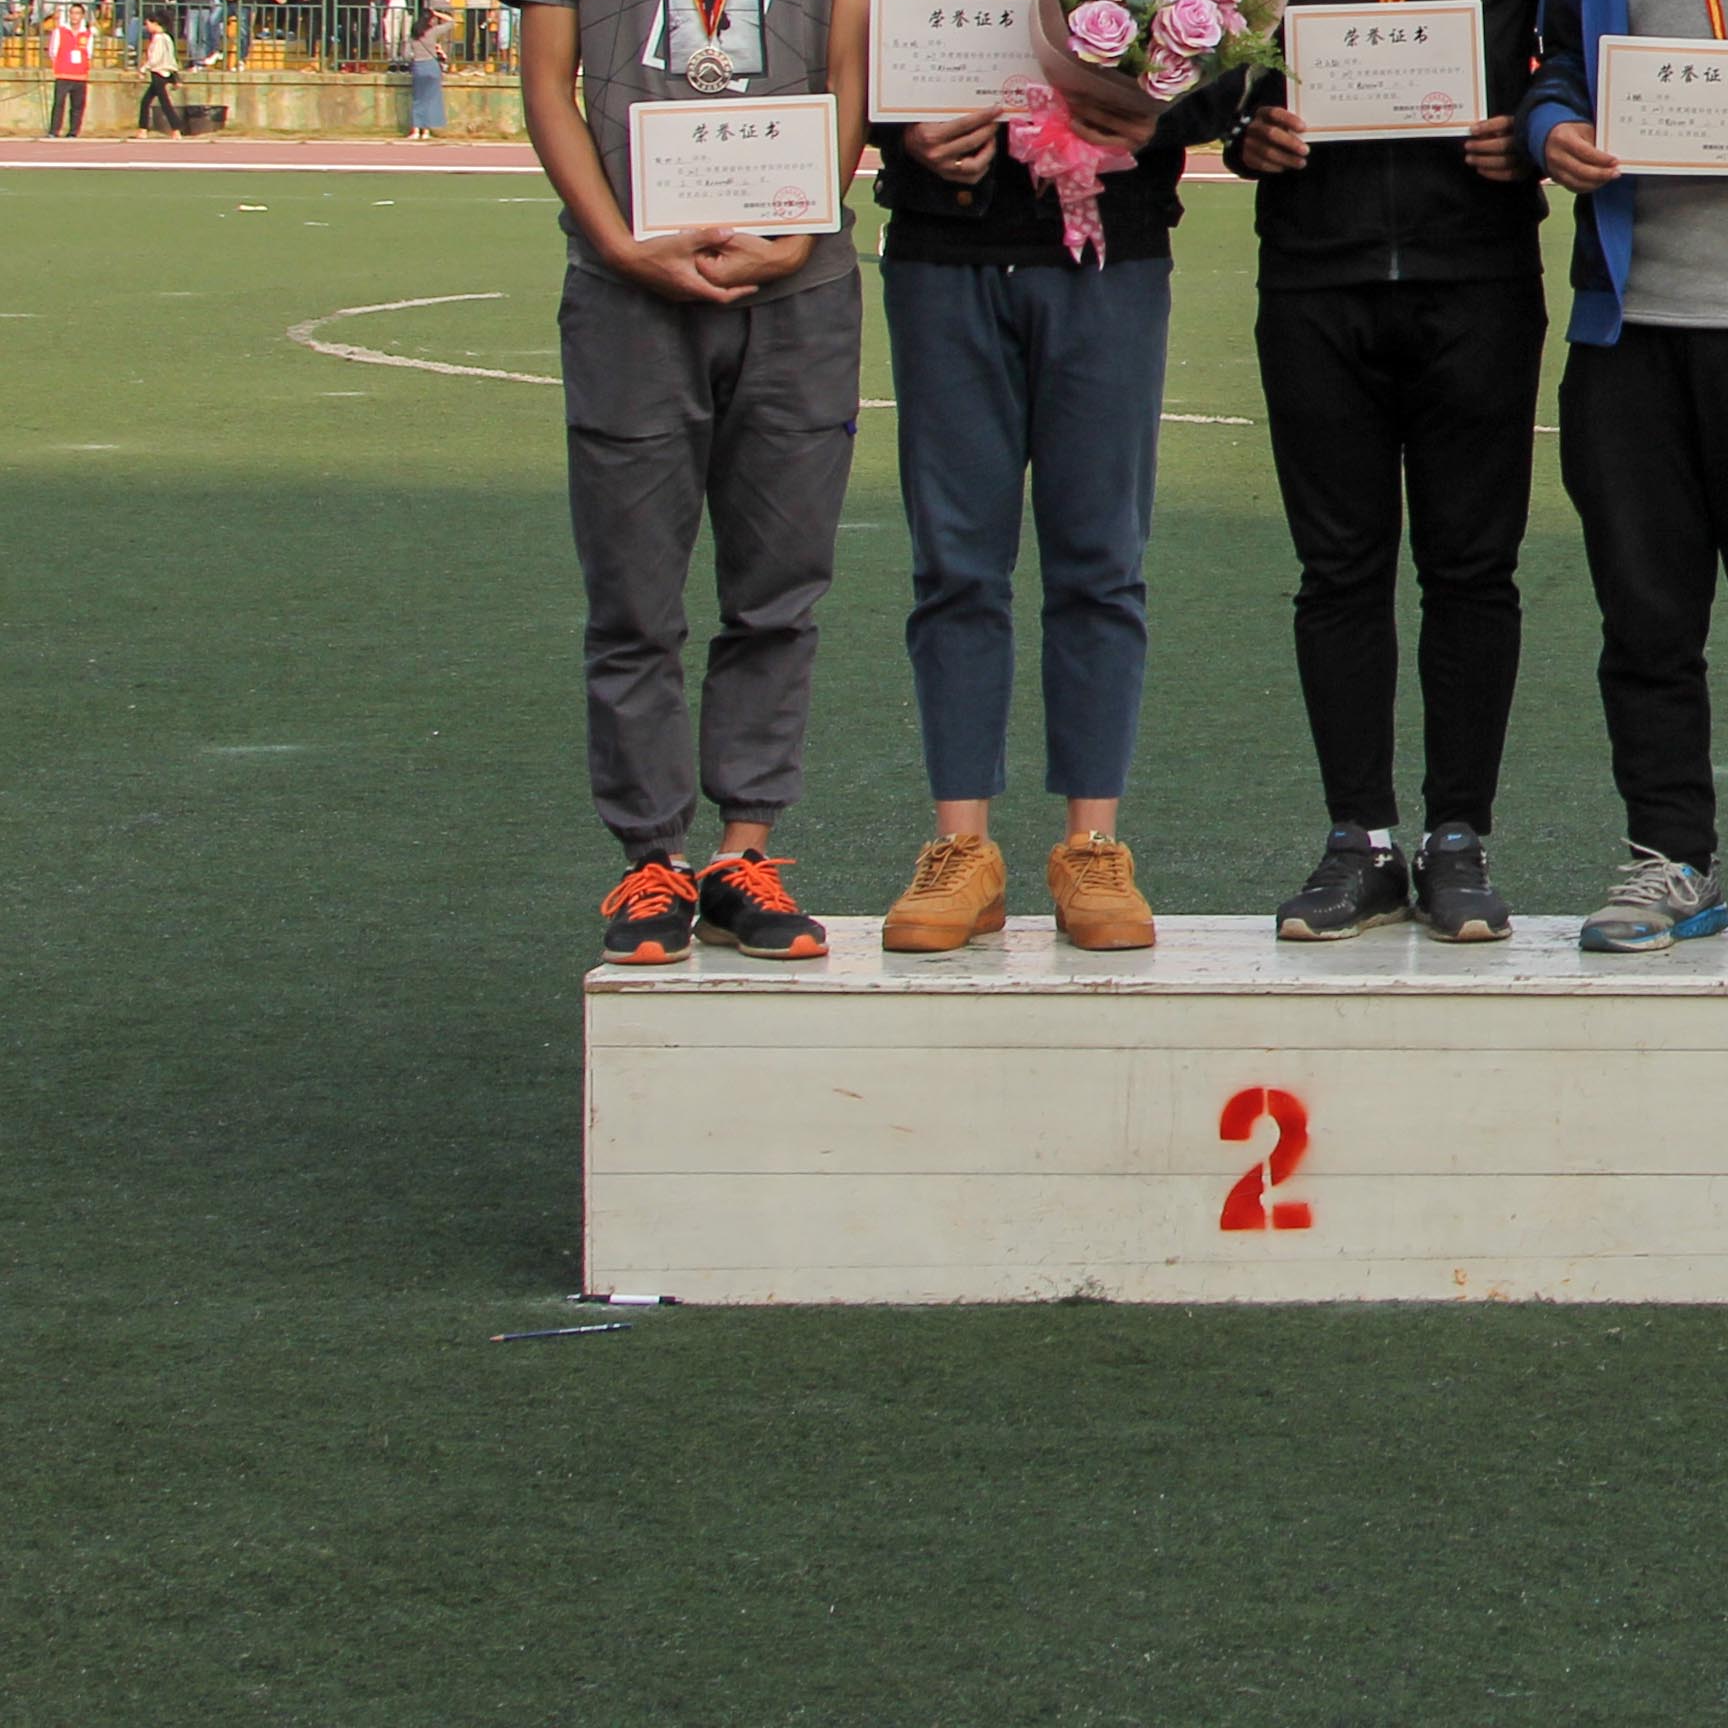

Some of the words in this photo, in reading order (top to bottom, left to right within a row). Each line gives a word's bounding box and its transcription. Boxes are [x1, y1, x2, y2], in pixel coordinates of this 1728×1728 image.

[928, 9, 1015, 28] 荣誉证书
[1344, 26, 1429, 47] 荣誉证书
[691, 121, 782, 143] 荣誉证书
[1220, 1086, 1313, 1231] 2
